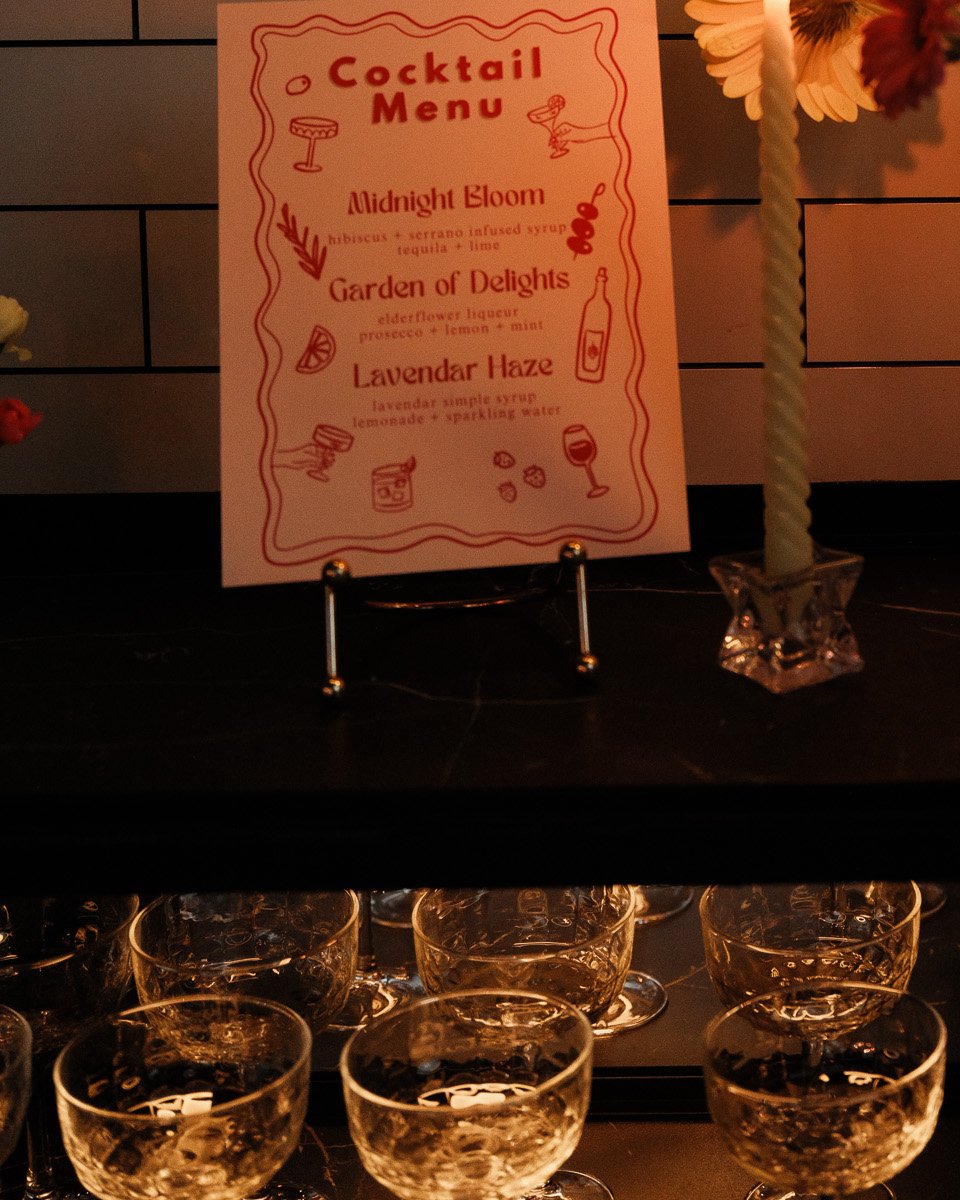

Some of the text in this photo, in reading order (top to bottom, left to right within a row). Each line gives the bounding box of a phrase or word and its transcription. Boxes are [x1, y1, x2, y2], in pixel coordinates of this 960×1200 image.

[328, 47, 542, 88] Cocktail
[371, 91, 503, 124] Menu
[348, 184, 545, 218] Midnight Bloom
[327, 233, 388, 246] hibiscus
[408, 227, 464, 241] serrano
[469, 224, 522, 238] infused
[526, 223, 567, 235] syrup
[397, 244, 448, 257] tequila
[469, 240, 499, 252] lime
[329, 267, 571, 303] Garden of Delights
[376, 307, 520, 326] elderflower liqueur
[359, 329, 424, 344] prosecco
[445, 323, 490, 336] lemon
[510, 319, 544, 332] mint
[352, 354, 554, 388] Lavendar Haze
[372, 391, 537, 413] lavendar simple syrup
[352, 413, 425, 429] lemonade
[445, 407, 515, 423] sparkling
[521, 405, 562, 417] water
